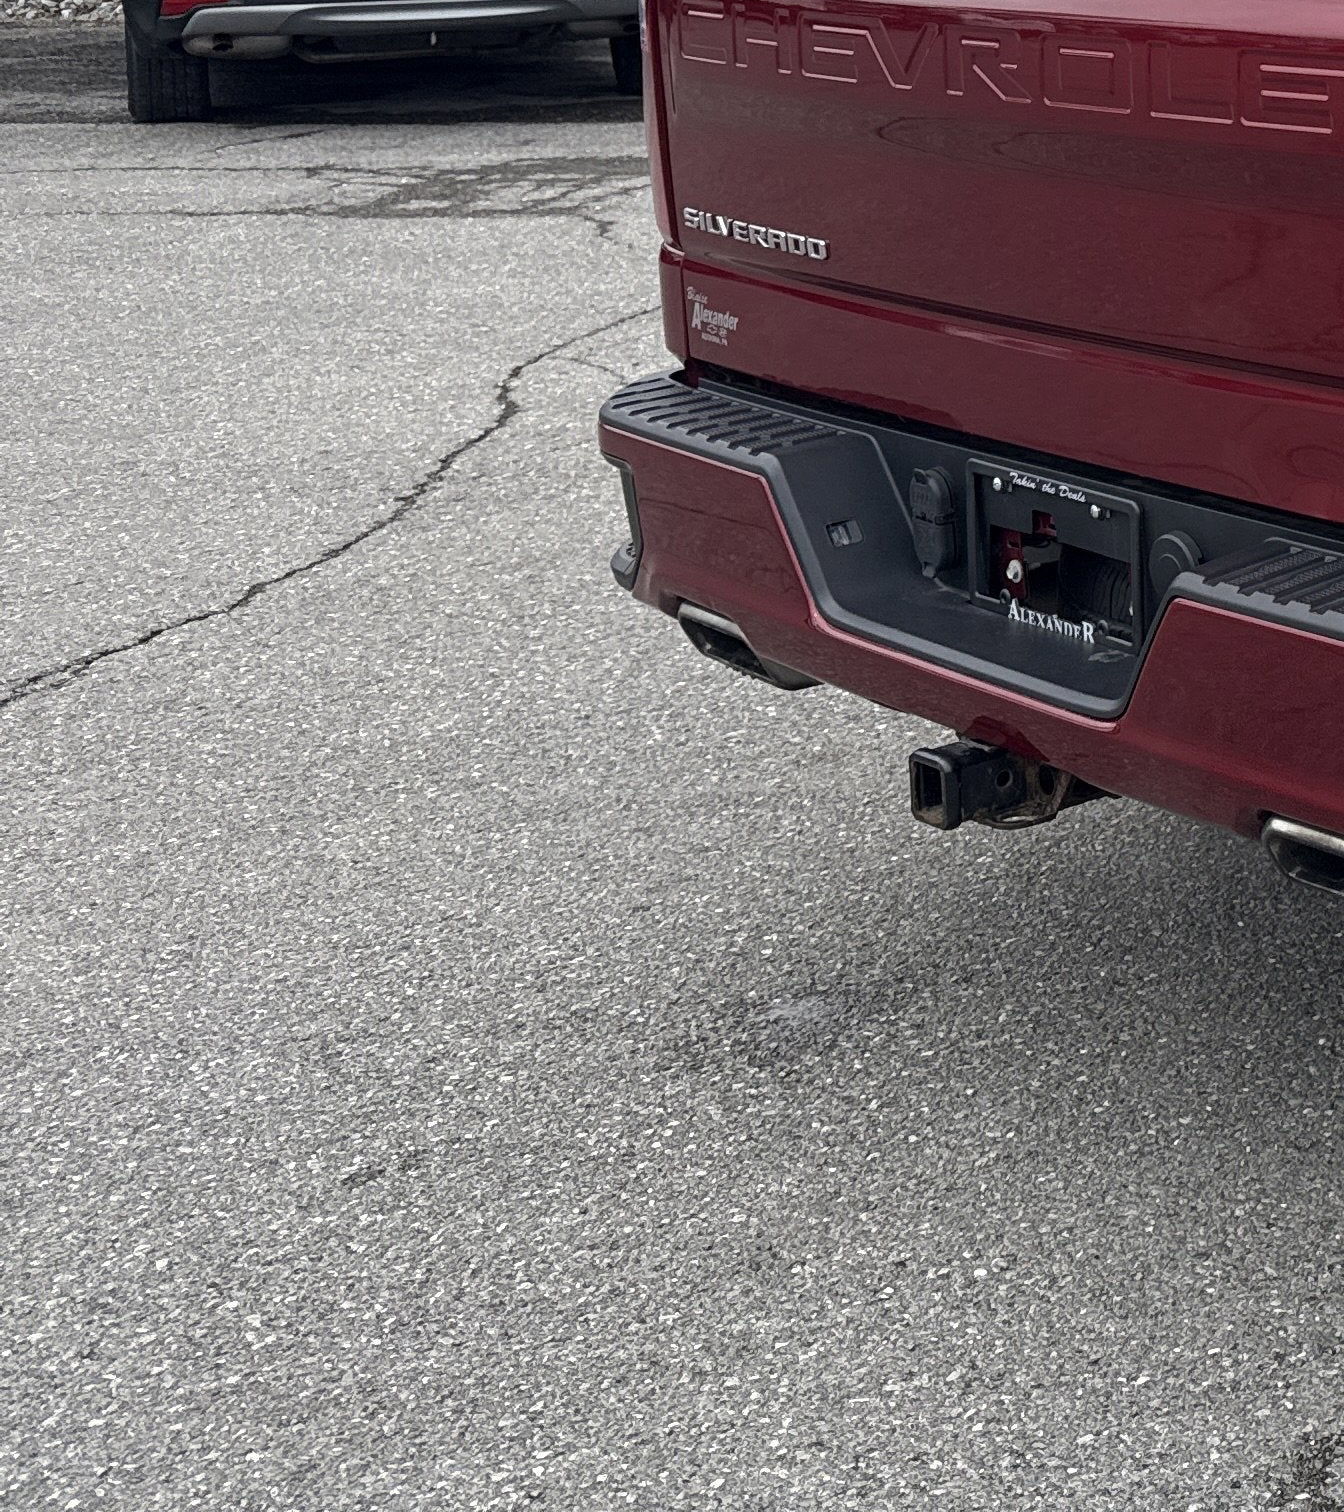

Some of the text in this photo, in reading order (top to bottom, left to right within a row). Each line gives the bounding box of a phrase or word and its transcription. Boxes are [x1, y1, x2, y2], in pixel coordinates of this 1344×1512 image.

[683, 206, 829, 261] SILVERADO
[691, 301, 739, 331] Alexander
[1009, 471, 1087, 503] Takin' the Deals
[1007, 598, 1095, 644] ALEXANDER
